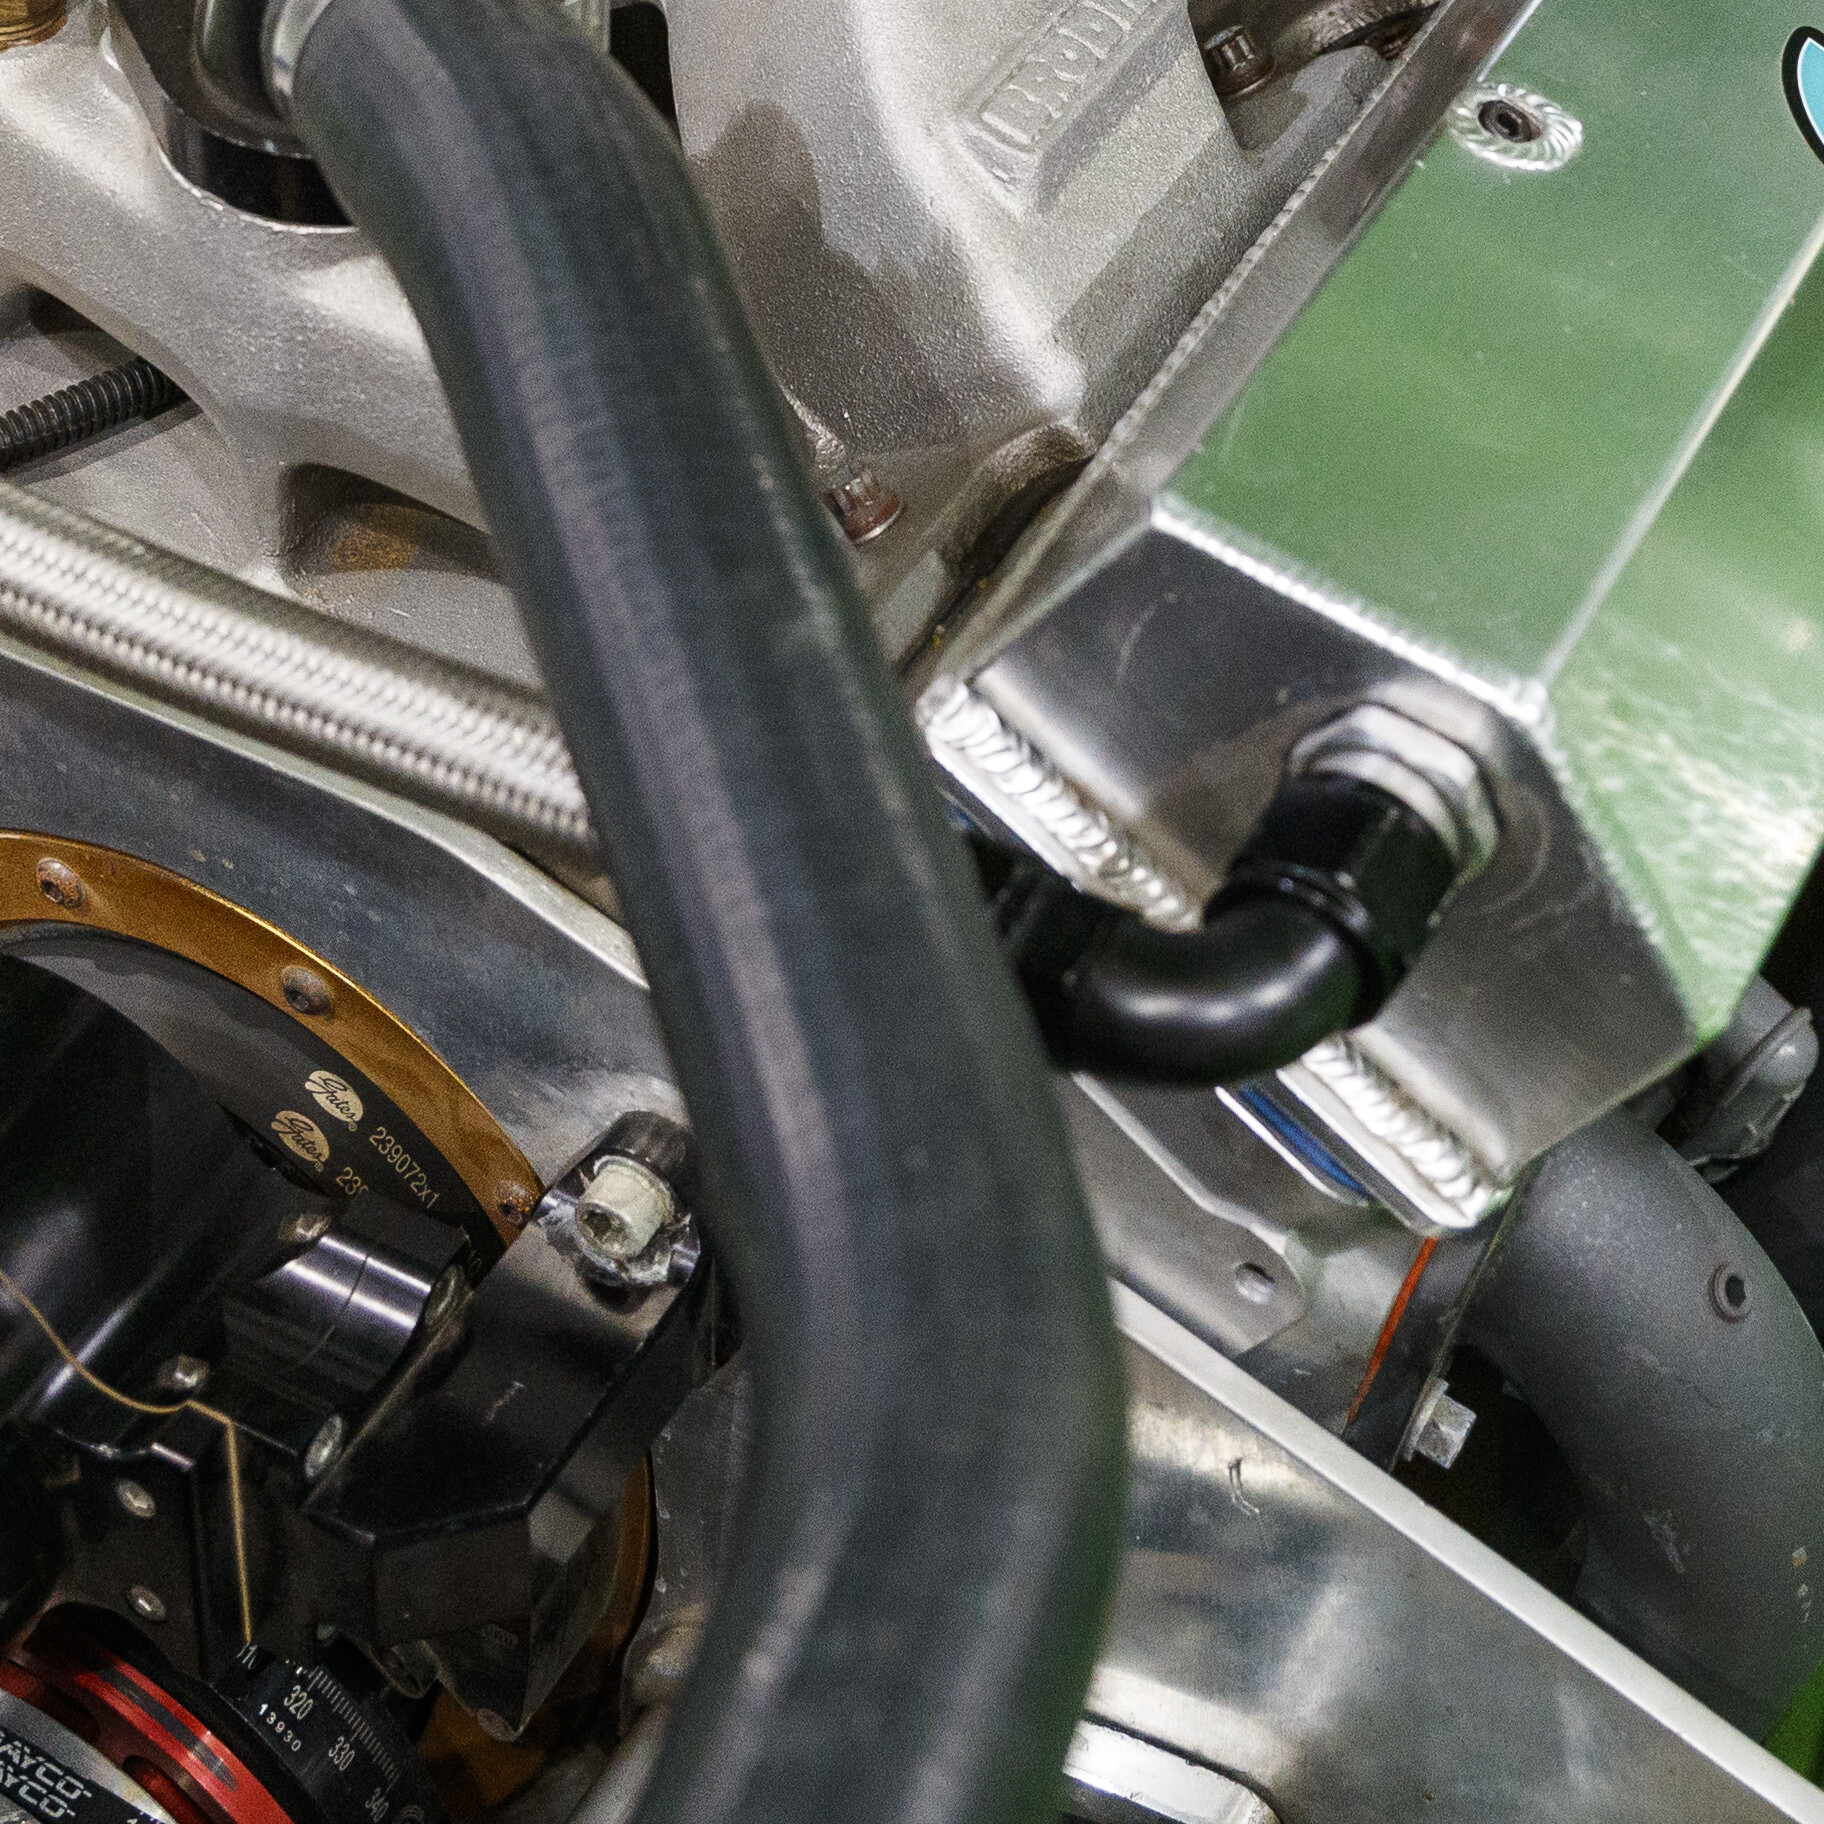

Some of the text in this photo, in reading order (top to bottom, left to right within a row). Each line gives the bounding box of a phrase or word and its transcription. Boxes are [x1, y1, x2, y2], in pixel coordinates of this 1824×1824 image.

[306, 1073, 358, 1123] Gates
[272, 1114, 325, 1167] Gates
[369, 1126, 440, 1209] 239072x1
[283, 1684, 314, 1721] 320
[328, 1735, 356, 1771] 330
[364, 1787, 390, 1824] 340
